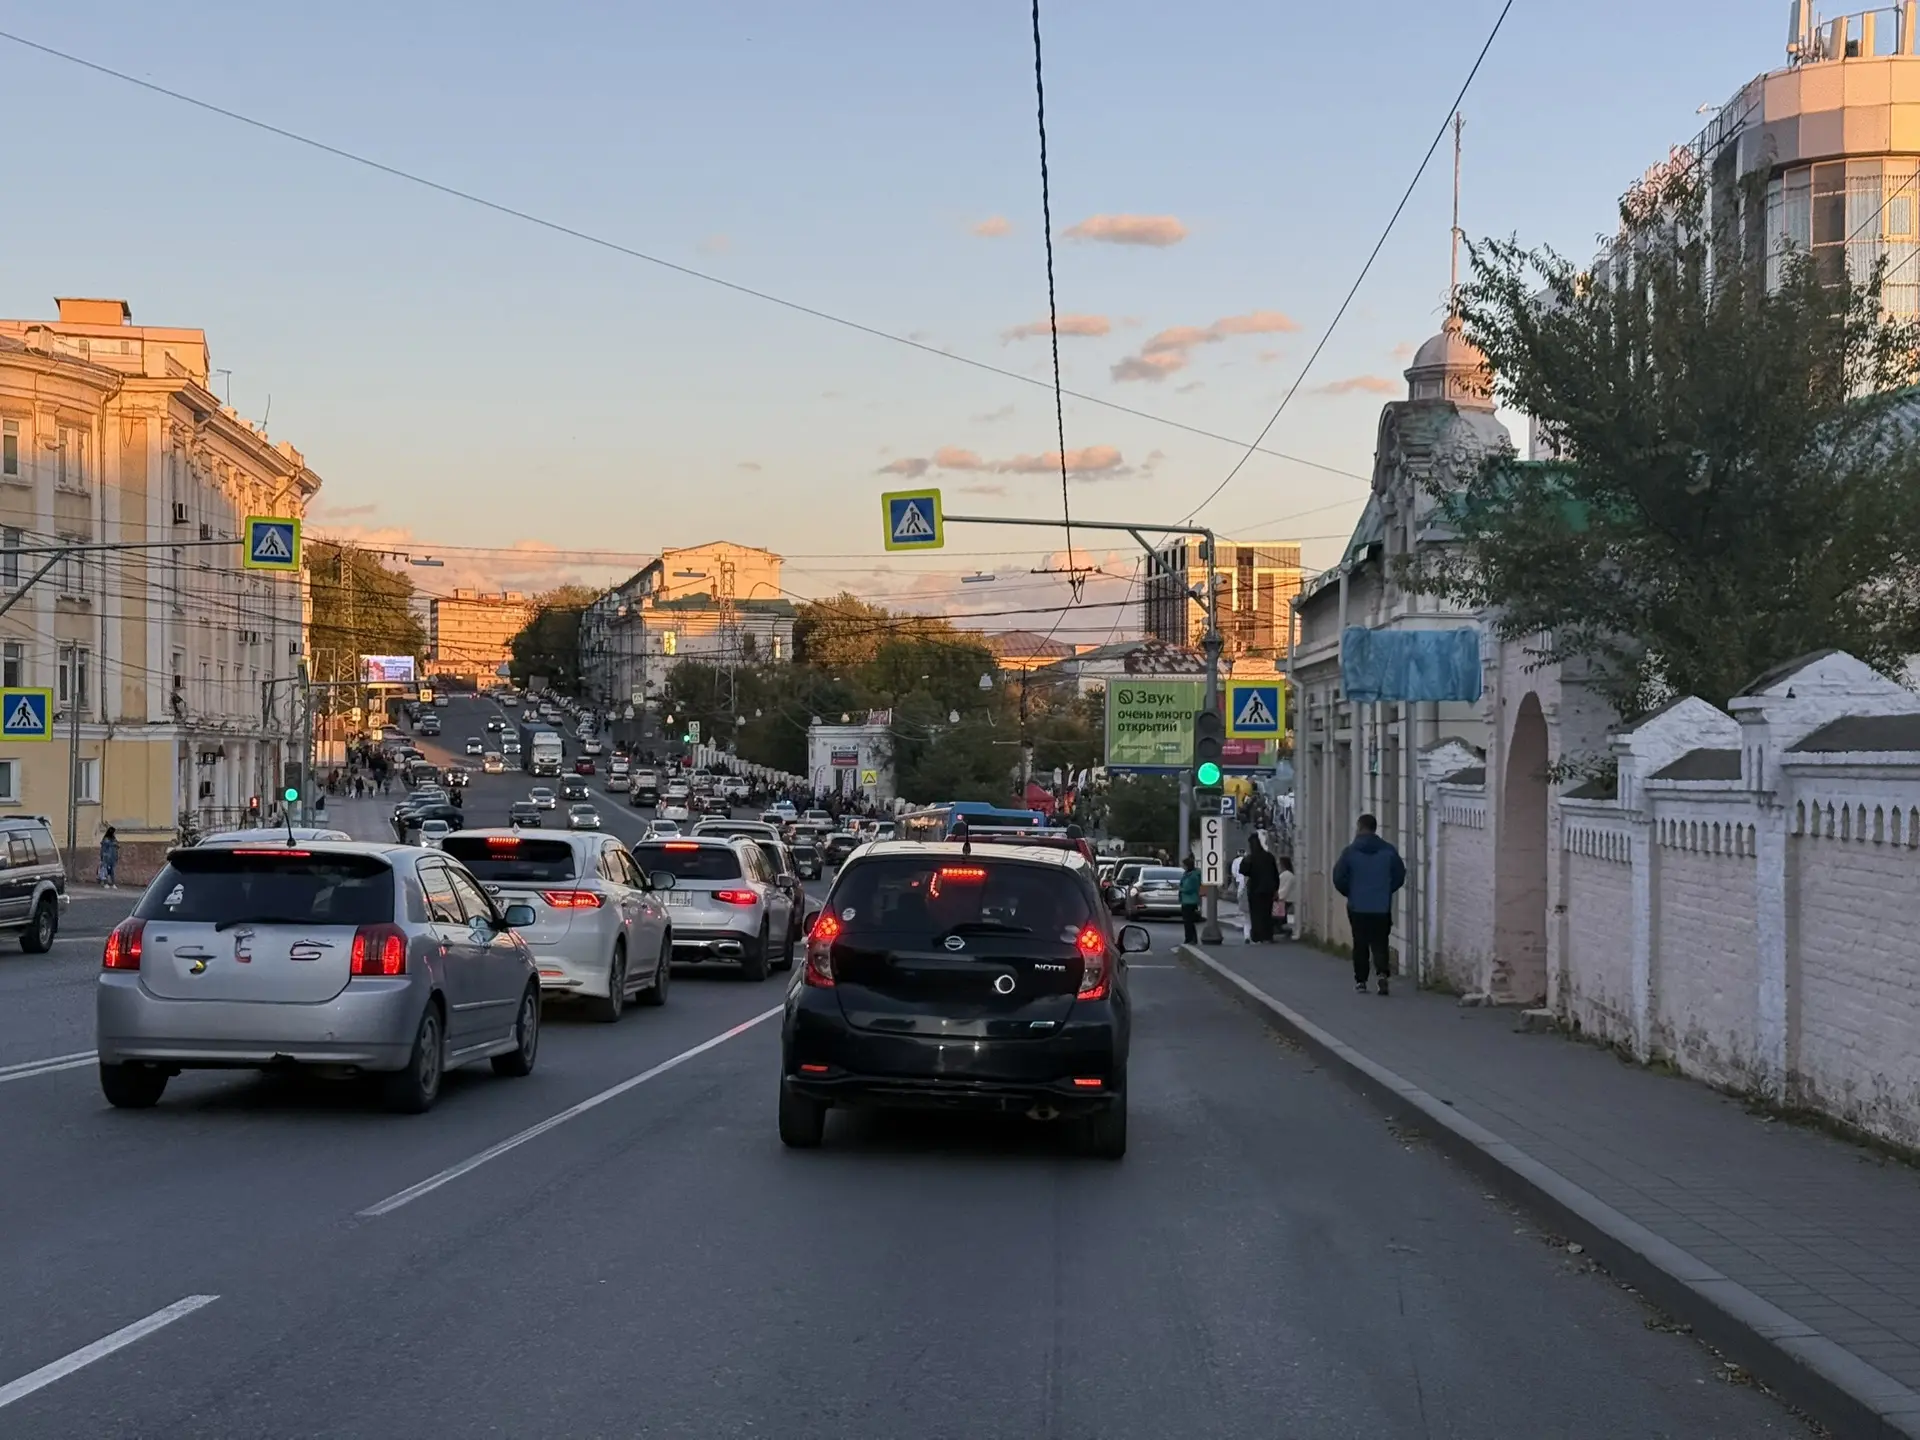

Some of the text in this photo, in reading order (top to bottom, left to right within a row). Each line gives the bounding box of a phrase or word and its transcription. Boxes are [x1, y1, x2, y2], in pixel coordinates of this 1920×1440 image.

[1136, 690, 1176, 706] Звук
[1117, 709, 1193, 720] очень много
[1117, 720, 1177, 733] открытий
[1206, 819, 1219, 882] СТОП
[1034, 963, 1066, 972] NOTE
